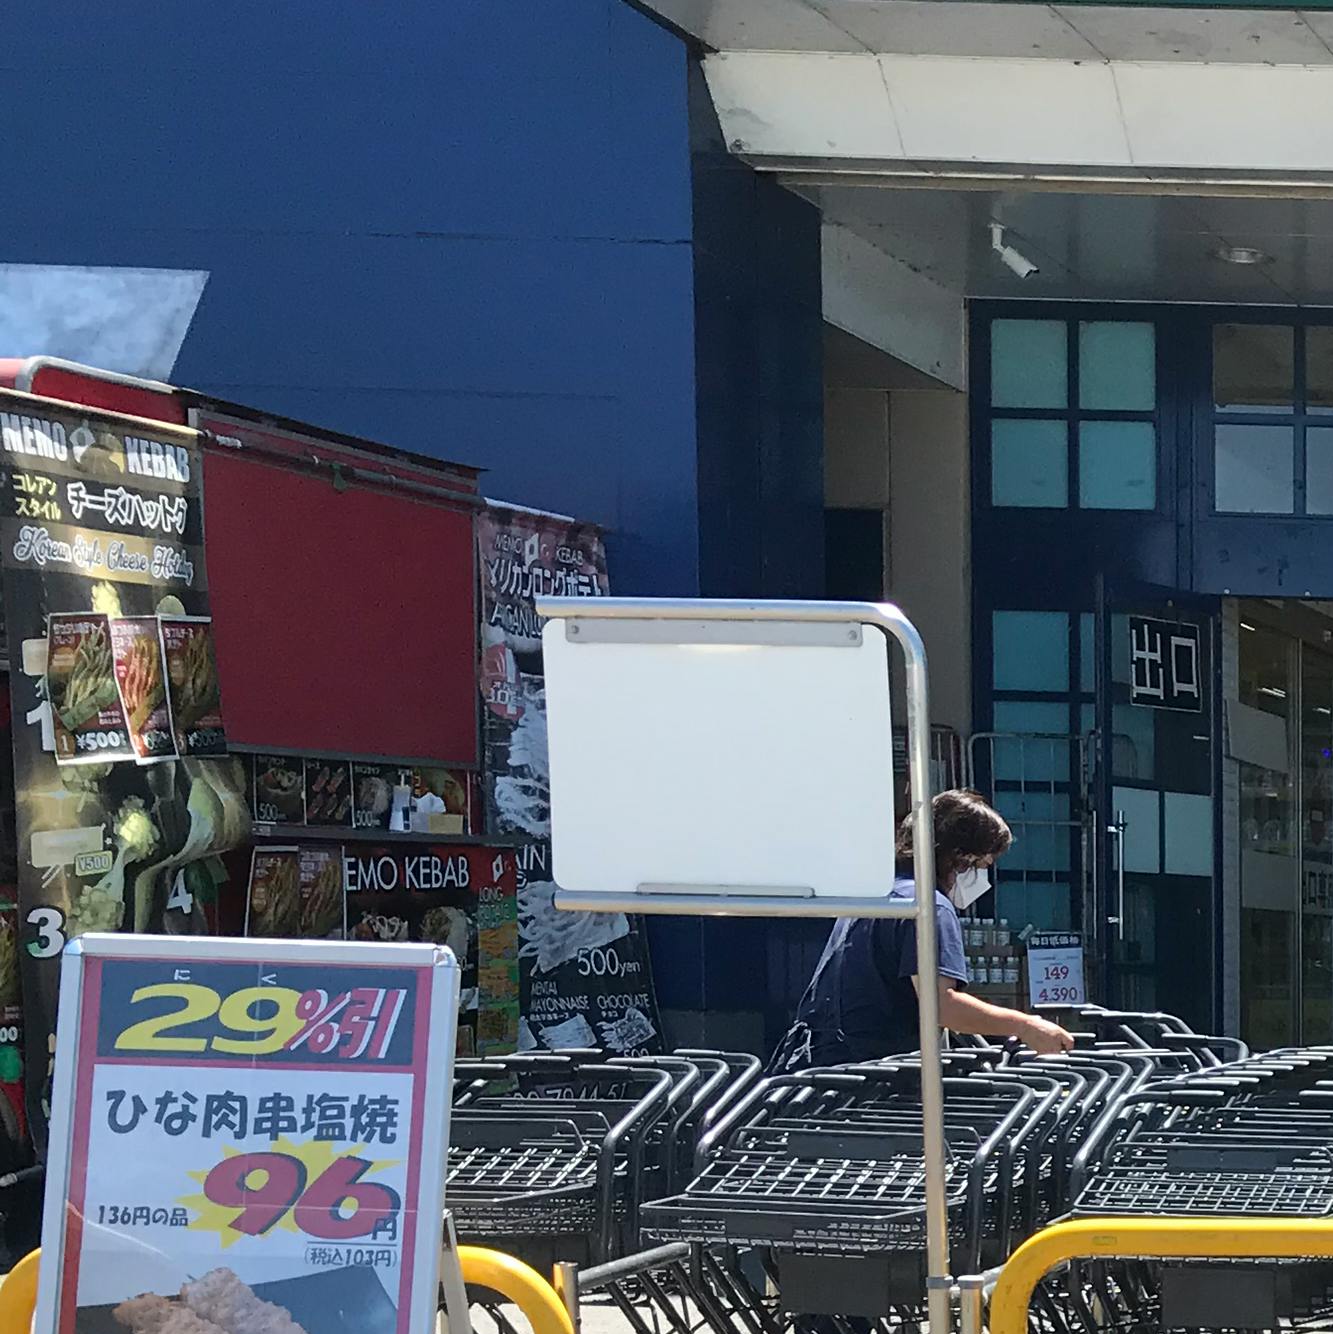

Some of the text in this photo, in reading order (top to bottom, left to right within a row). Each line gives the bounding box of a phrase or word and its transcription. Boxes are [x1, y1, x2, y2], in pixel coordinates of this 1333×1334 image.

[0, 411, 191, 484] MEMO KEBAB
[12, 473, 57, 496] コレアン
[15, 496, 62, 520] スタイル
[13, 525, 73, 565] Korean
[106, 541, 150, 573] Cheese
[1131, 623, 1199, 700] 出口
[405, 856, 470, 889] KEBAB
[26, 907, 65, 958] 3
[173, 968, 278, 986] に く
[1044, 965, 1069, 980] 149
[596, 994, 650, 1009] CHOCOLATE
[114, 983, 408, 1060] 29%引
[105, 1089, 400, 1144] ひな肉串塩焼
[97, 1205, 189, 1227] 136円の品
